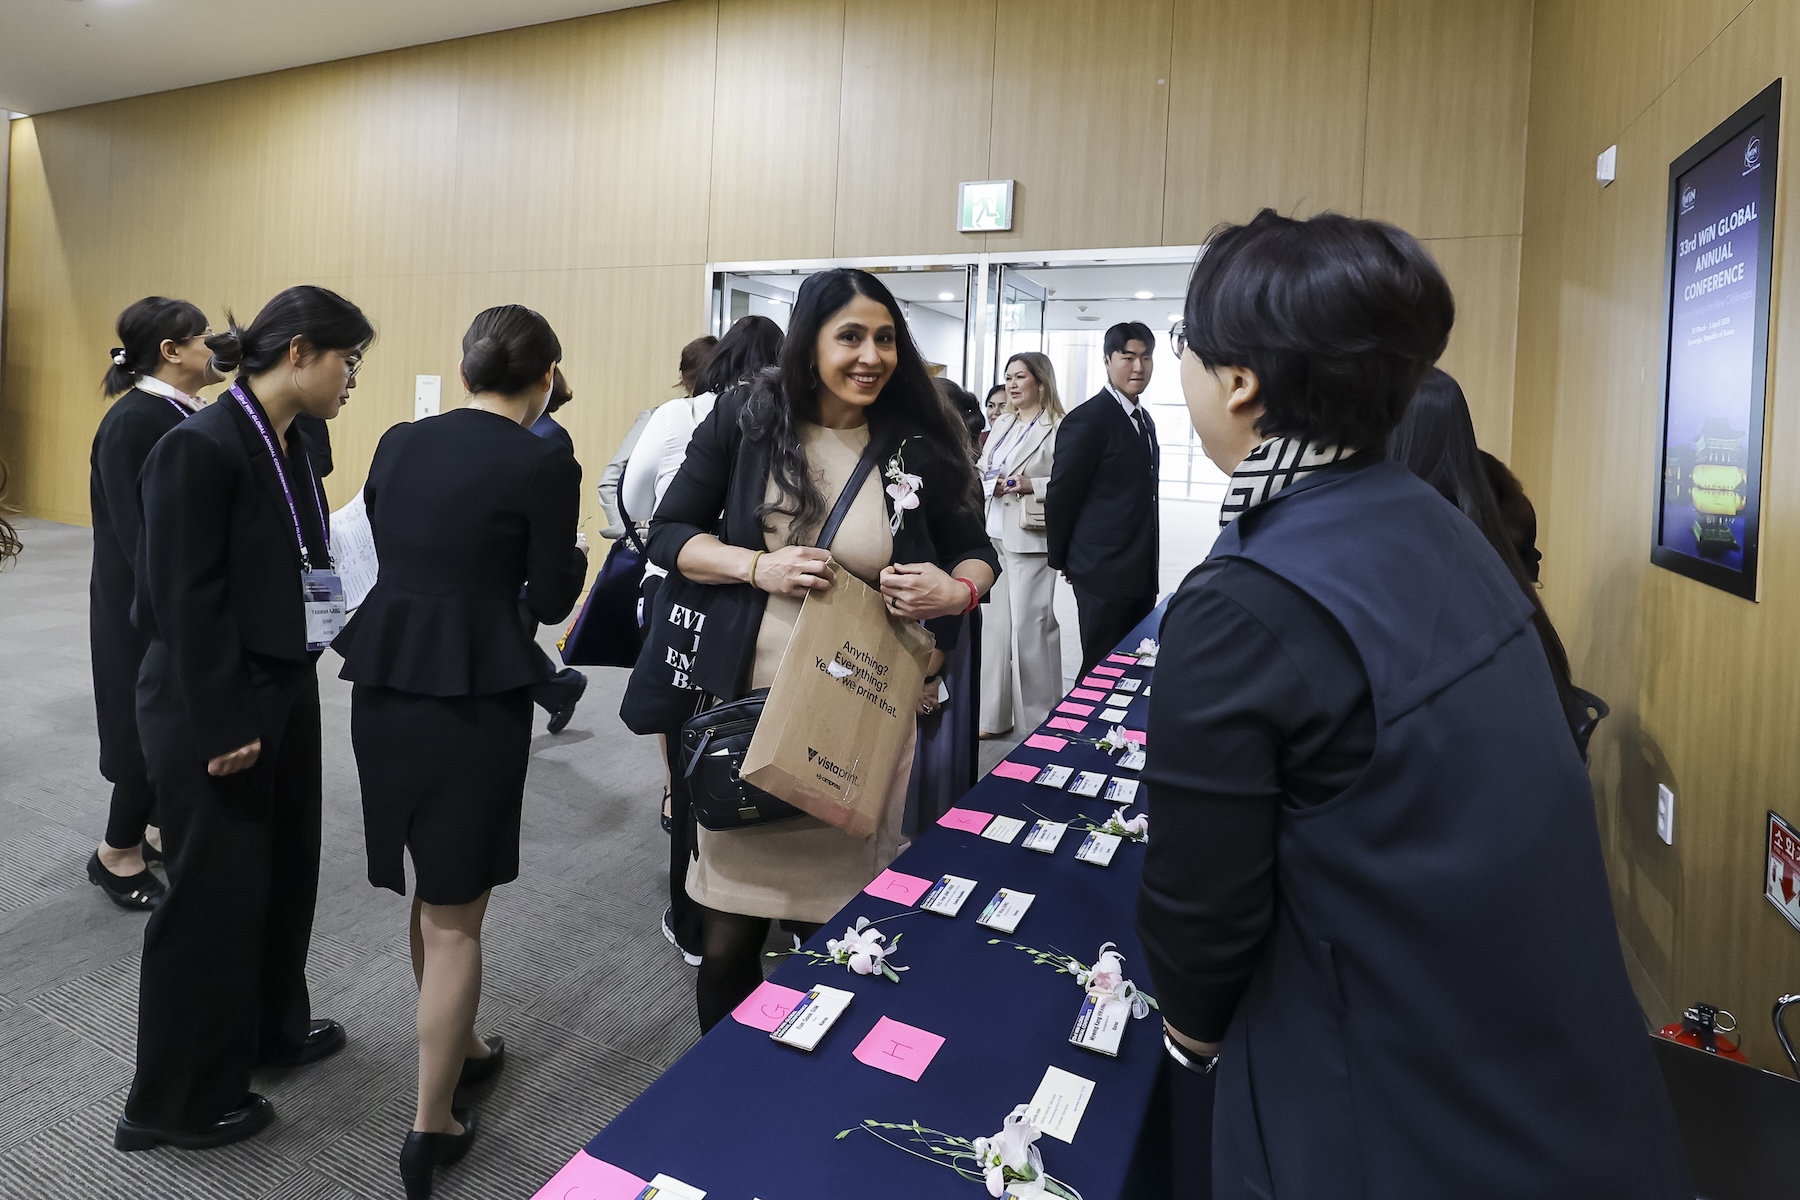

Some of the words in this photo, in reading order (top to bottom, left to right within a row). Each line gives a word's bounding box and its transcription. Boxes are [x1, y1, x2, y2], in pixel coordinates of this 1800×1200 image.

[1679, 237, 1696, 257] 33rd
[1698, 223, 1716, 247] WiN
[1718, 201, 1758, 237] GLOBAL
[1695, 241, 1733, 273] ANNUAL
[1684, 262, 1744, 301] CONFERENCE
[236, 394, 246, 405] 33rd
[251, 414, 266, 435] GLOBAL
[263, 434, 276, 457] ANNUAL
[273, 457, 289, 493] CONFERENCE
[834, 651, 888, 693] Everything?
[842, 641, 889, 676] Anything?
[842, 676, 856, 690] we
[856, 685, 878, 705] print
[879, 698, 897, 718] that.
[887, 879, 909, 894] J
[760, 1003, 790, 1019] G
[882, 1040, 913, 1061] H
